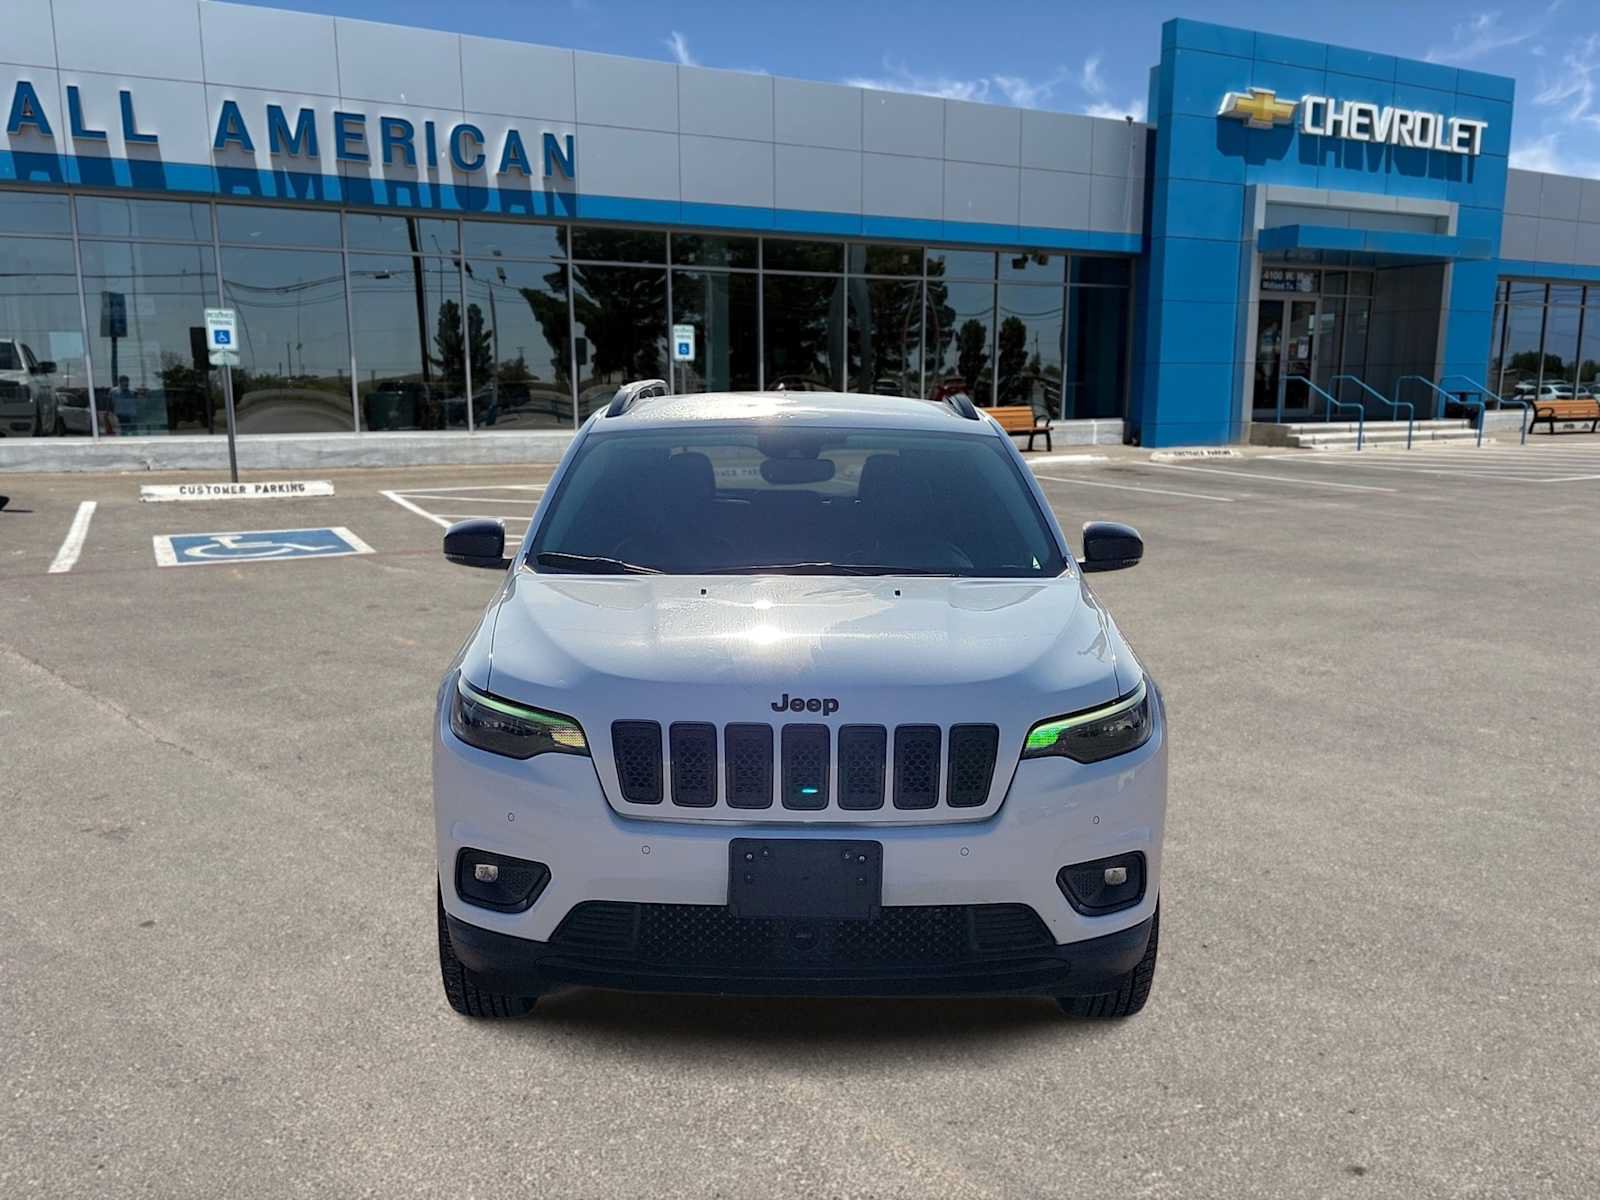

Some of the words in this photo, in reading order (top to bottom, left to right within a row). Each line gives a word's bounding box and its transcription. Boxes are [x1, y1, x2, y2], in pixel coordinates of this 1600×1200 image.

[7, 81, 158, 143] ALL
[213, 100, 575, 179] AMERICAN
[1302, 95, 1488, 155] CHEVROLET
[179, 485, 246, 495] CUSTOMER
[254, 483, 305, 493] PARKING
[771, 694, 839, 716] Jeep
